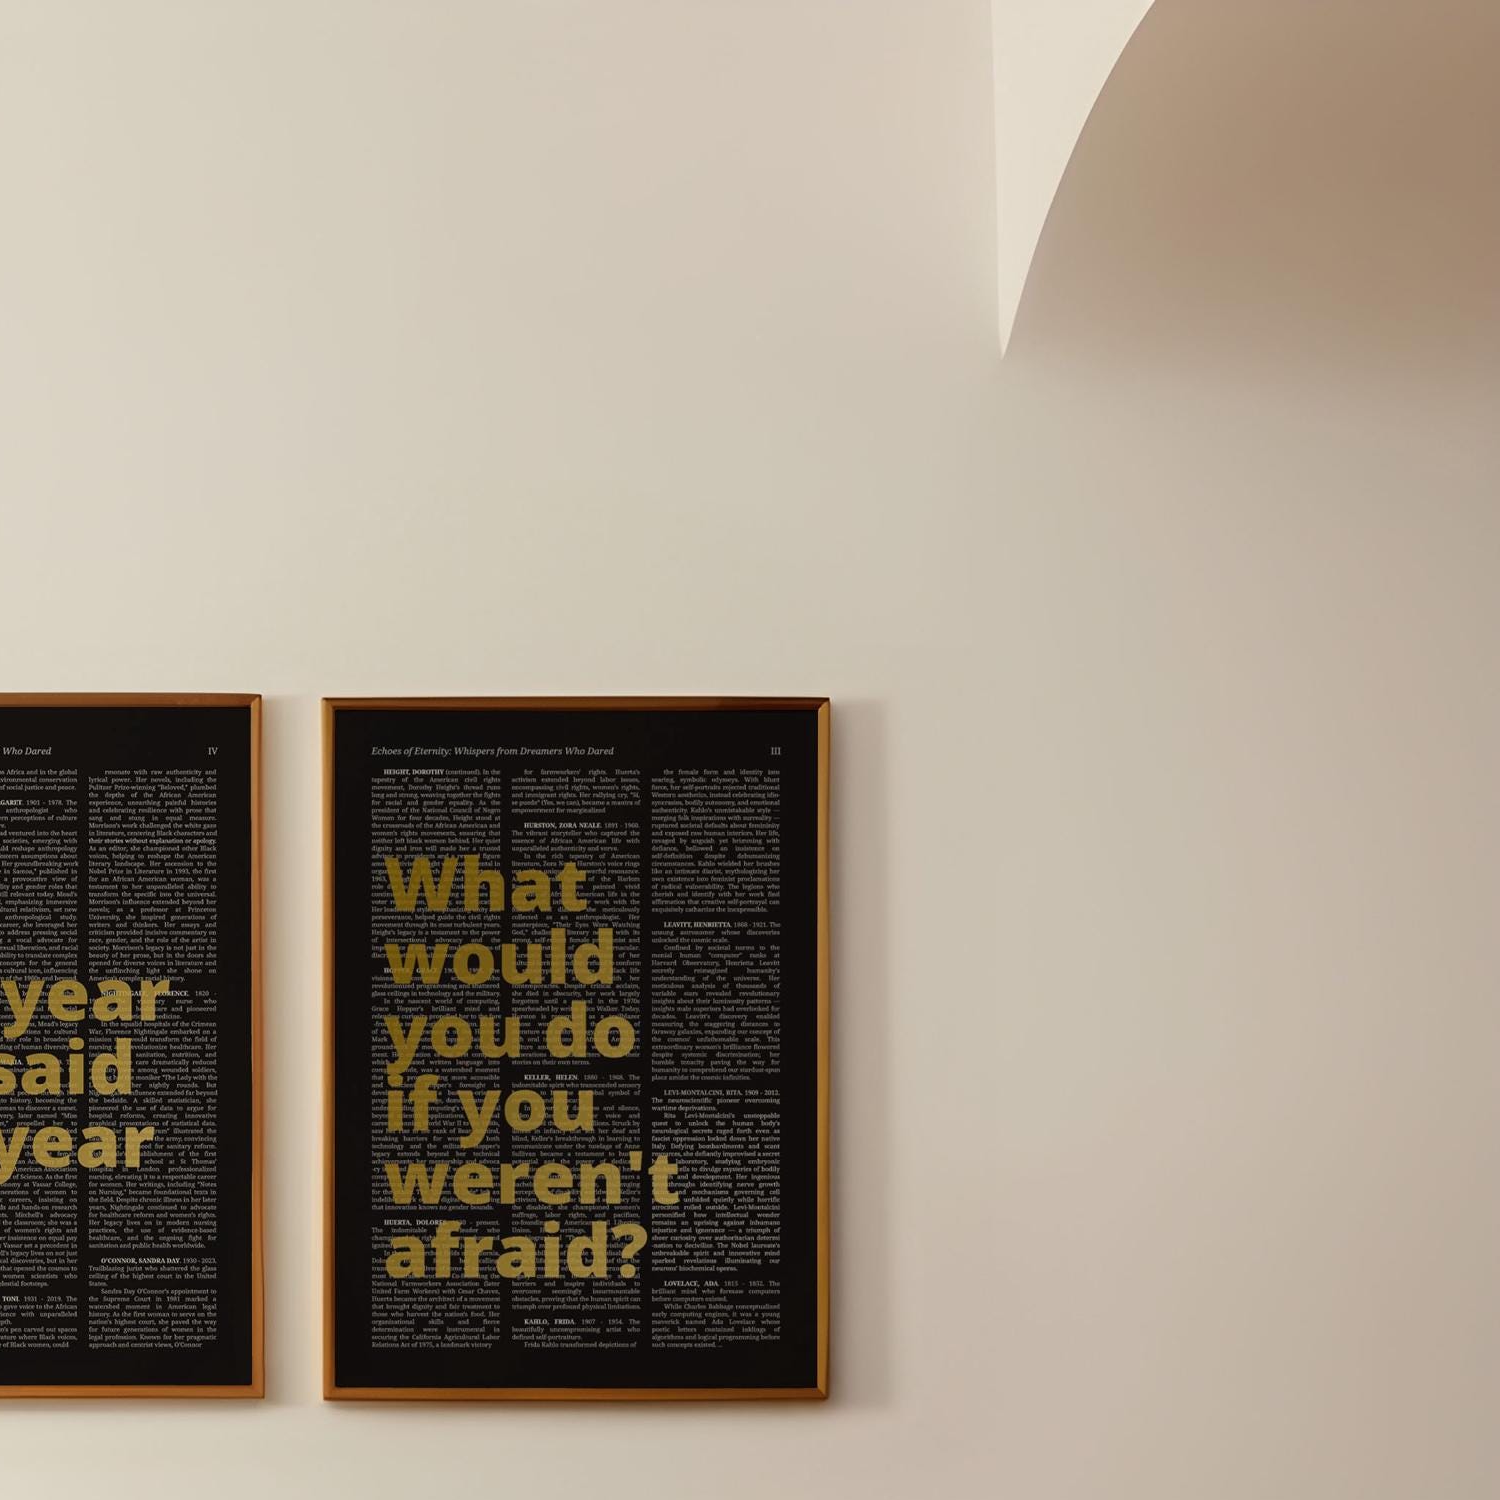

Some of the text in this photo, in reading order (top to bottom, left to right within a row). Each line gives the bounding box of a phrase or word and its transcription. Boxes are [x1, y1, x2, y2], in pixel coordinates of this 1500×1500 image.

[2, 746, 23, 755] Who
[24, 746, 52, 755] Dared
[208, 746, 219, 755] IV
[371, 746, 614, 757] Echoes of Eternity: Whispers from Dreamers Who Dared
[771, 746, 781, 755] III
[384, 768, 410, 776] HEIGHT,
[524, 821, 557, 829] HURSTON,
[385, 854, 587, 912] What
[384, 928, 613, 985] would
[1, 980, 170, 1038] year
[385, 1001, 635, 1073] you do
[524, 1073, 551, 1081] KELLER,
[388, 1074, 593, 1148] if you
[384, 1152, 679, 1204] weren't
[385, 1220, 647, 1278] afraid?
[101, 1256, 137, 1264] O'CONNOR,
[664, 1279, 700, 1287] LOVELACE,
[524, 1317, 549, 1325] KAHLO,
